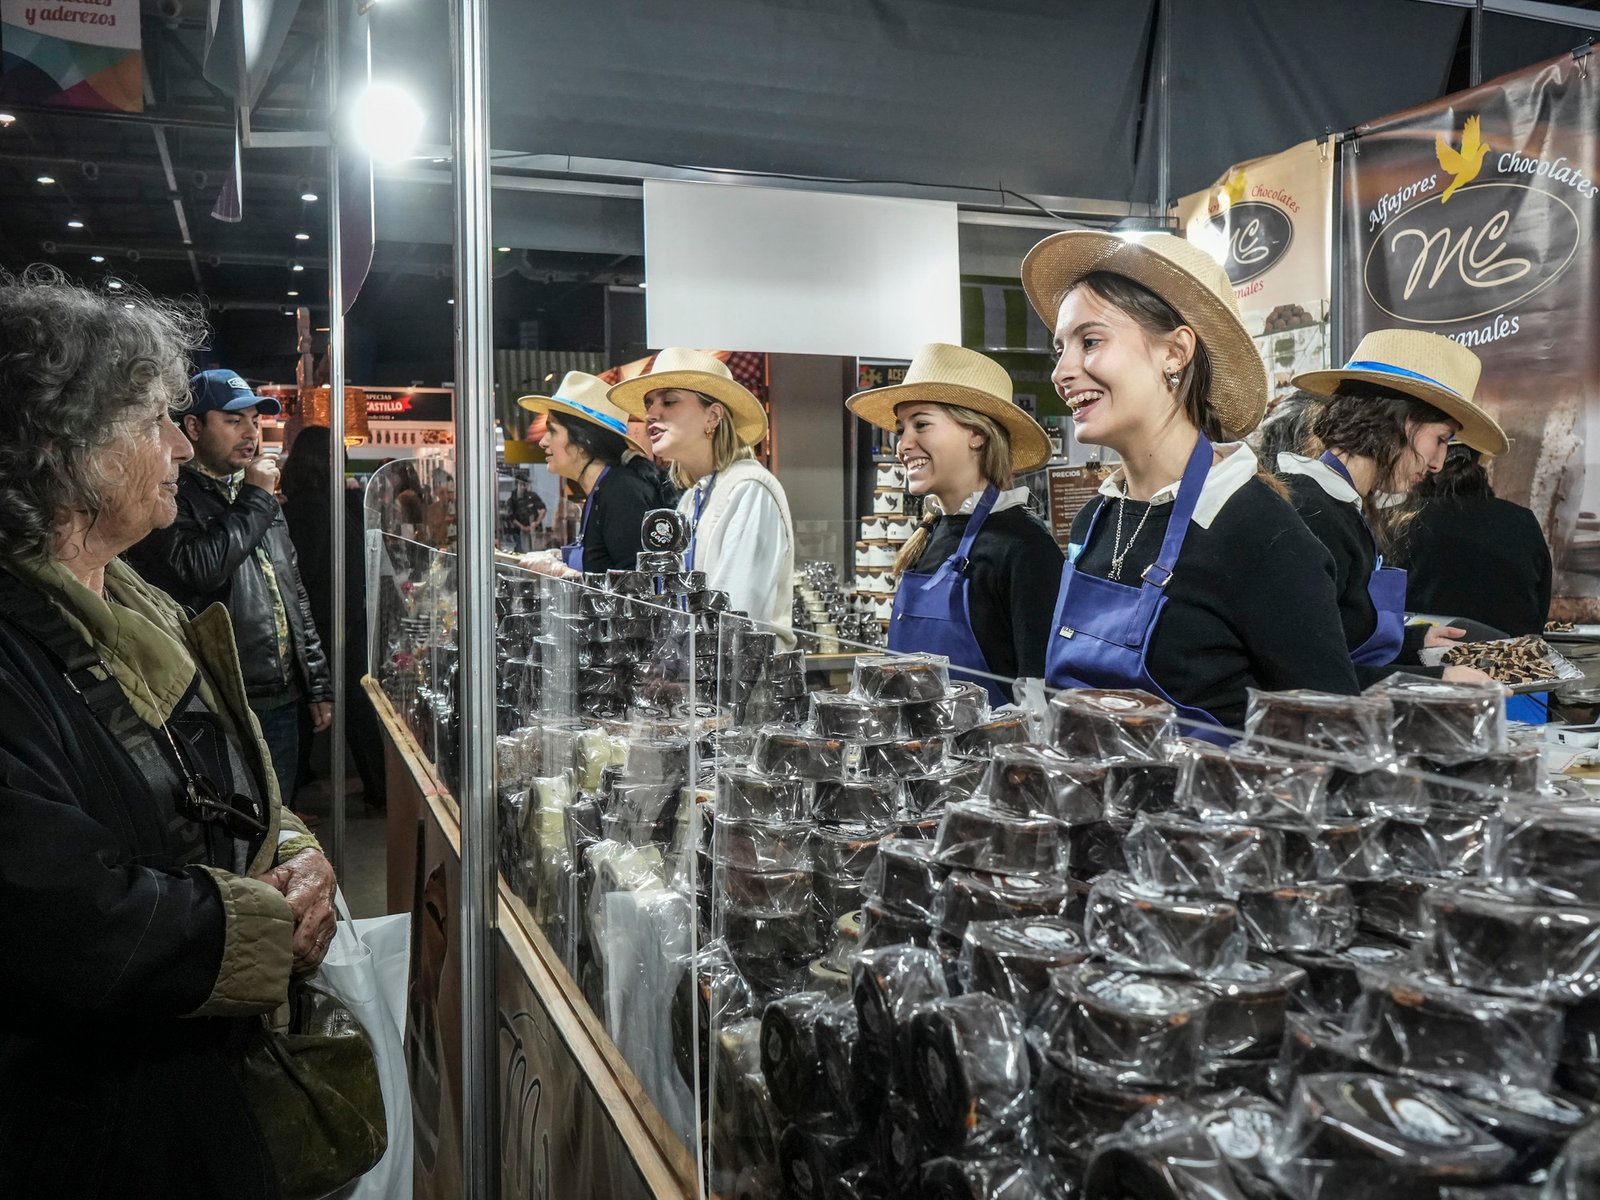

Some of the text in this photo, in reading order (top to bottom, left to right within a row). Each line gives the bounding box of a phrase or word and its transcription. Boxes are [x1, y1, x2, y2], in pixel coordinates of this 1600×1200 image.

[25, 6, 116, 26] y aderezos
[1497, 150, 1599, 200] Chocolates
[1251, 184, 1301, 214] Chocolates
[1369, 174, 1437, 232] Alfajores
[1234, 279, 1264, 299] nales
[1442, 313, 1520, 348] sanales
[1052, 470, 1080, 478] PRECIOS
